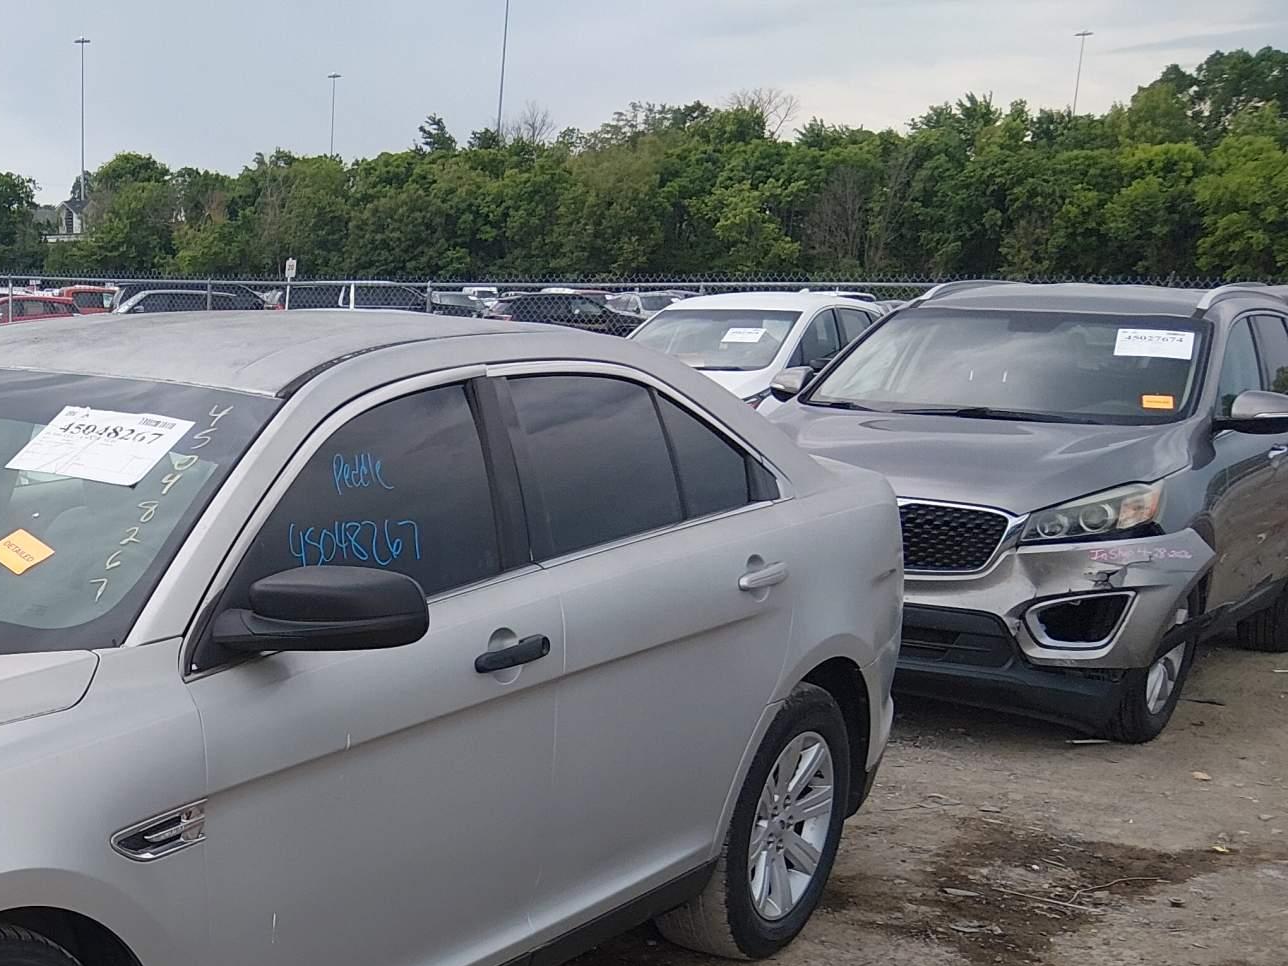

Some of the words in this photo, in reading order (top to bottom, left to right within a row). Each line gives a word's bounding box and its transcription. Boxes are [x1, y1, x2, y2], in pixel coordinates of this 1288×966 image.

[59, 421, 166, 446] 45048267
[2, 540, 35, 563] DETAILED
[288, 519, 422, 568] 45048267
